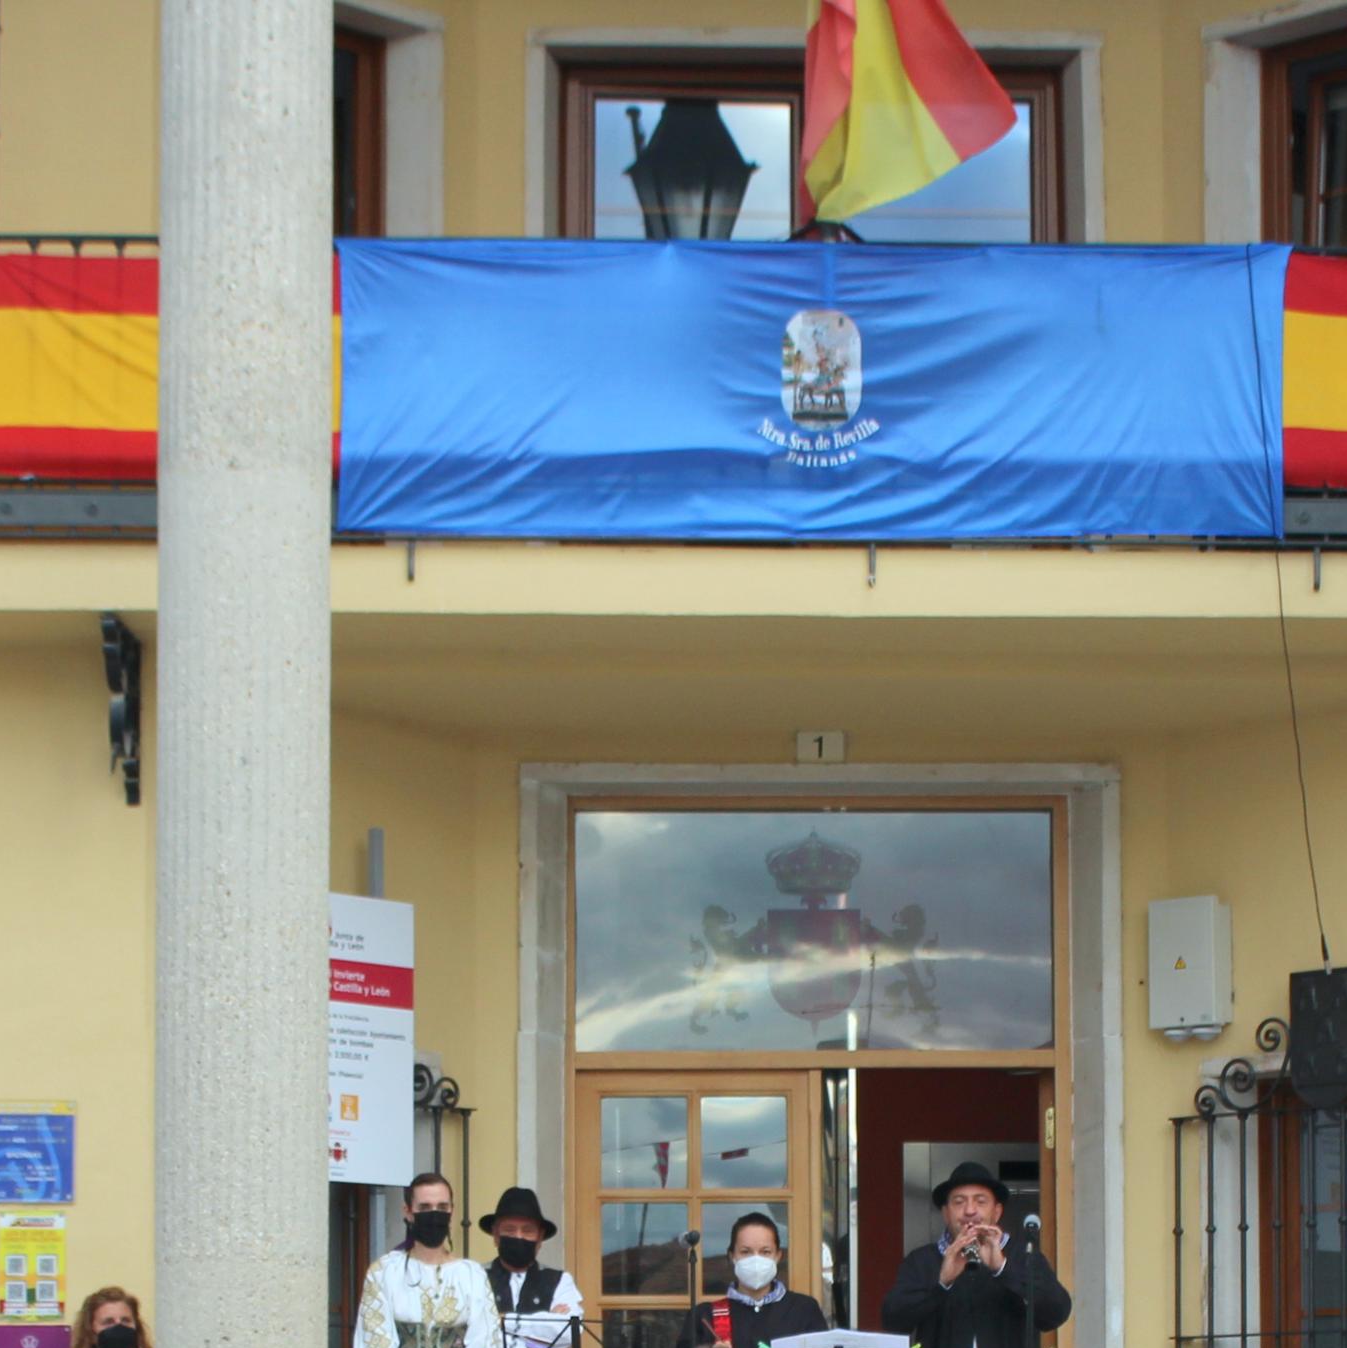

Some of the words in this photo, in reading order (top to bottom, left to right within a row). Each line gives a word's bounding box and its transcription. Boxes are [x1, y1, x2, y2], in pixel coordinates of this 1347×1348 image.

[757, 417, 789, 447] Ntra.
[789, 431, 814, 452] Sra.
[815, 433, 831, 452] de
[833, 418, 880, 450] Revilla
[812, 735, 824, 759] 1
[333, 969, 366, 982] Invierte
[333, 980, 363, 995] Castilla
[371, 984, 391, 998] León
